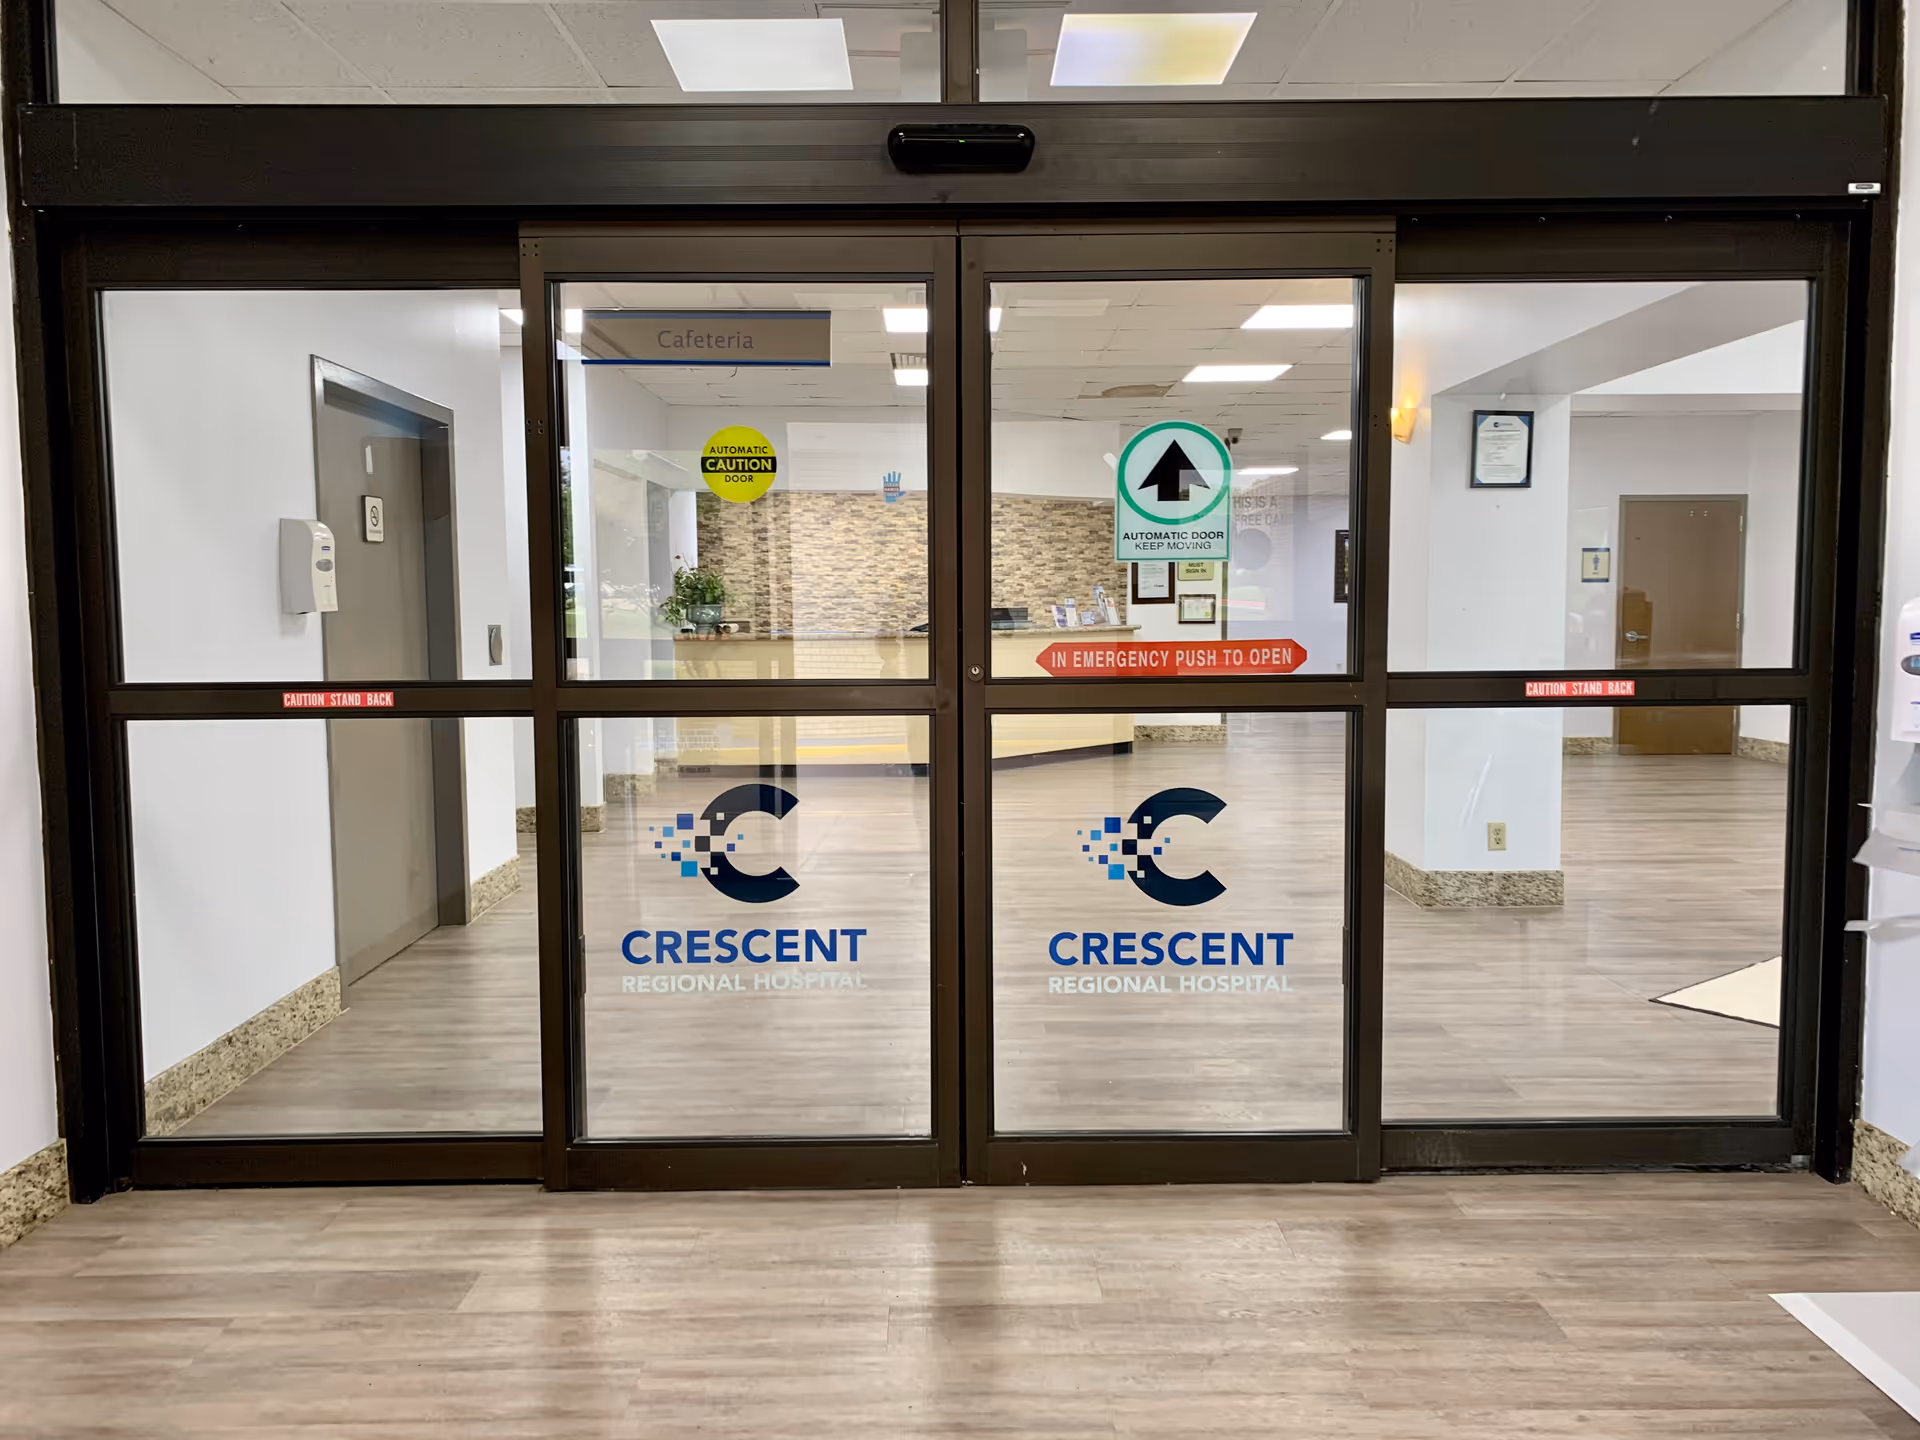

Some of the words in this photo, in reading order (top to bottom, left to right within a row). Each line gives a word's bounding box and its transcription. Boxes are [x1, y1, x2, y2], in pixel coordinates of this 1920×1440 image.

[658, 329, 754, 349] Cafeteria
[709, 446, 768, 454] AUTOMATIC
[706, 458, 772, 471] CAUTION
[724, 474, 754, 483] DOOR
[1123, 532, 1188, 540] AUTOMATIC
[1191, 531, 1224, 540] DOOR
[1135, 542, 1164, 550] KEEP
[1167, 541, 1212, 550] MOVING
[1052, 651, 1066, 668] IN
[1073, 650, 1169, 668] EMERGENCY
[1175, 649, 1217, 667] PUSH
[1223, 649, 1243, 666] TO
[1250, 647, 1292, 665] OPEN
[1526, 682, 1567, 696] CAUTION
[1572, 682, 1602, 695] STAND
[1608, 682, 1633, 694] BACK
[284, 693, 325, 706] CAUTION
[330, 693, 360, 706] STAND
[367, 693, 392, 706] BACK
[621, 929, 868, 965] CRESCENT
[1048, 931, 1294, 966] CRESCENT
[622, 974, 746, 993] REGIONAL
[754, 971, 867, 990] HOSPITAL
[1049, 976, 1172, 994] REGIONAL
[1180, 975, 1294, 993] HOSPITAL
